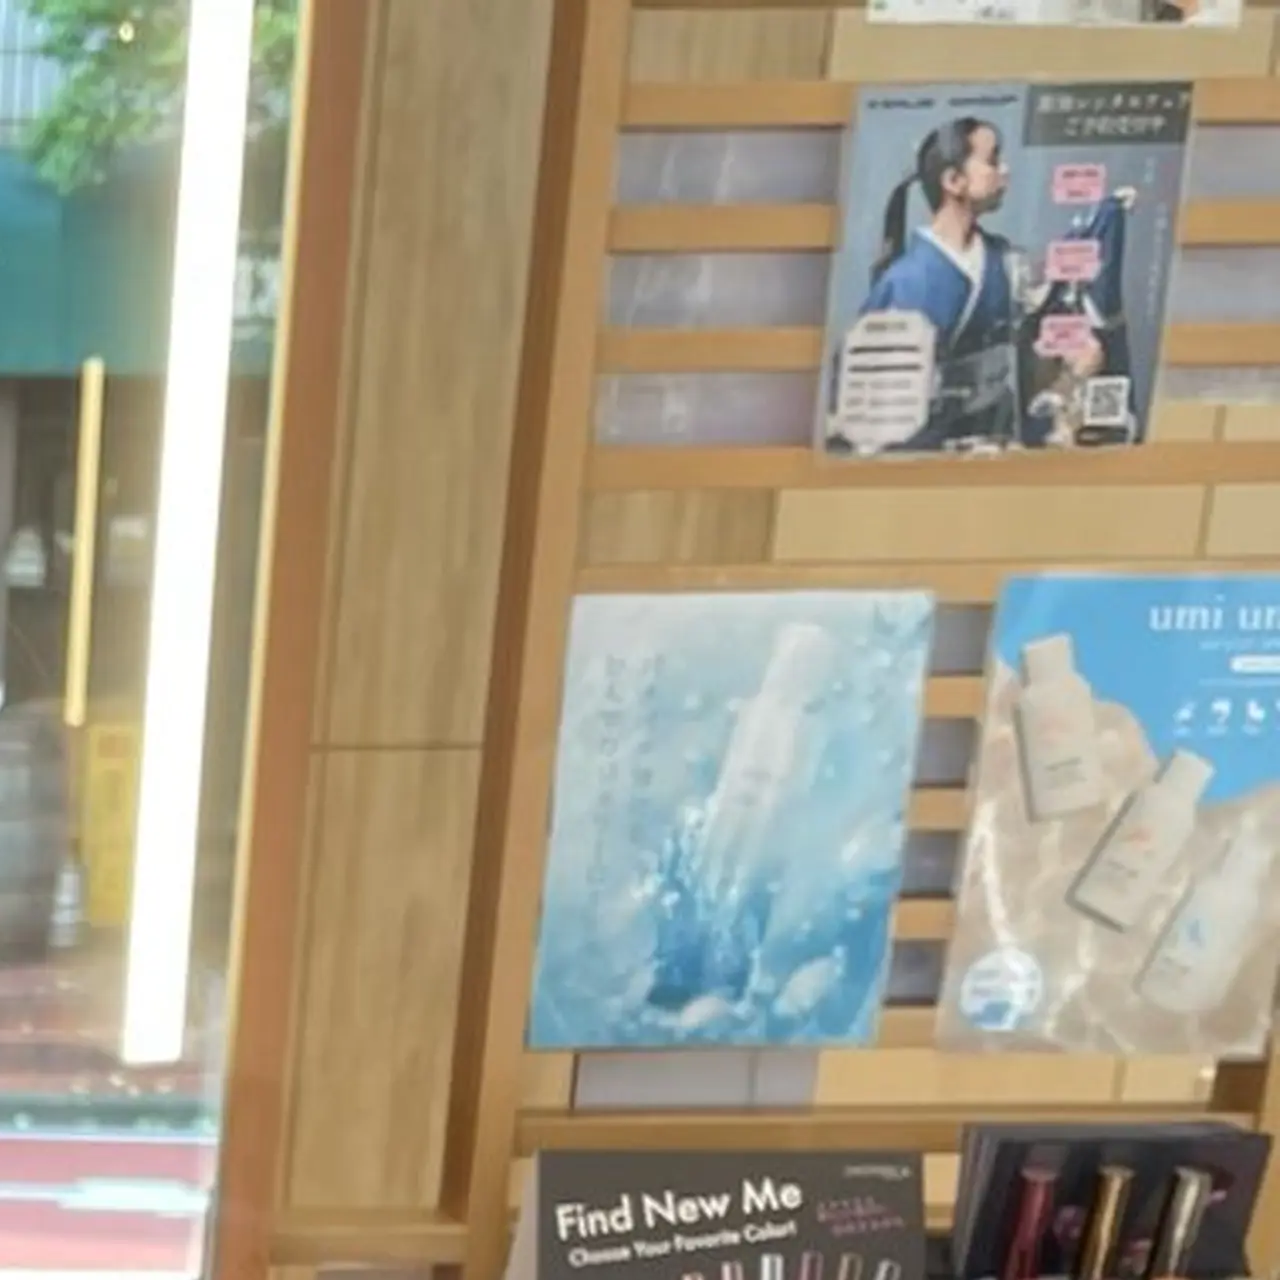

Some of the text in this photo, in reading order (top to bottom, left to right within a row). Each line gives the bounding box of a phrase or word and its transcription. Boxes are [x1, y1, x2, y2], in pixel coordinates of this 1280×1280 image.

[1150, 594, 1223, 632] umi
[555, 1176, 802, 1241] Find New Me
[633, 1240, 672, 1257] Your
[673, 1230, 740, 1251] Favorite
